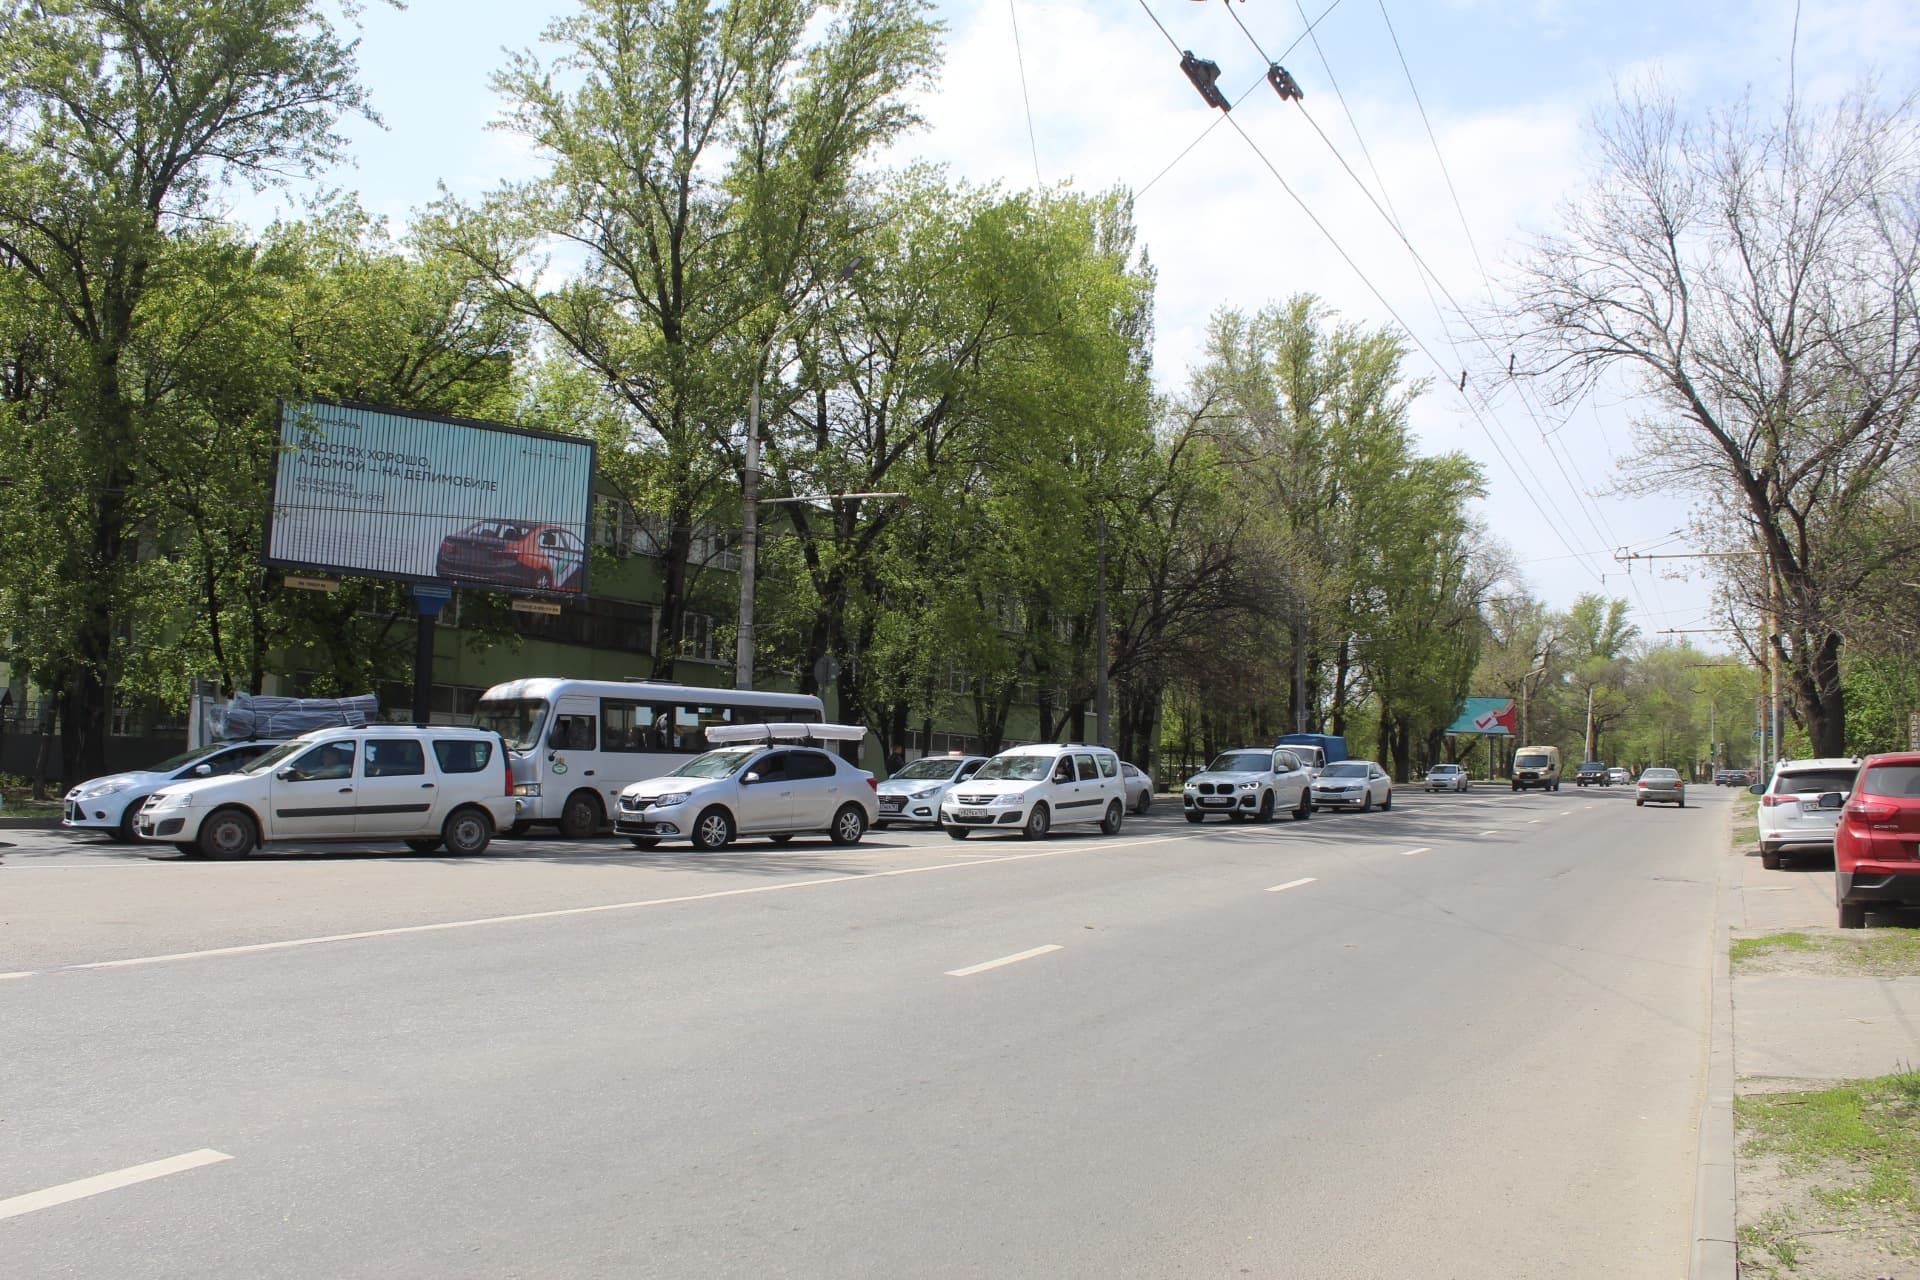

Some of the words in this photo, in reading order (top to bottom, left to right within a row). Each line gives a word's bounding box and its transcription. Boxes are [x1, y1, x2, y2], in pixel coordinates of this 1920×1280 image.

[367, 449, 431, 469] ХОРОШО,
[298, 454, 308, 465] А
[310, 455, 365, 473] ДОМОЙ
[383, 466, 401, 478] НА
[404, 469, 497, 491] ДЕЛИМОБИЛЕ
[311, 486, 363, 500] ПРОМОКОДУ
